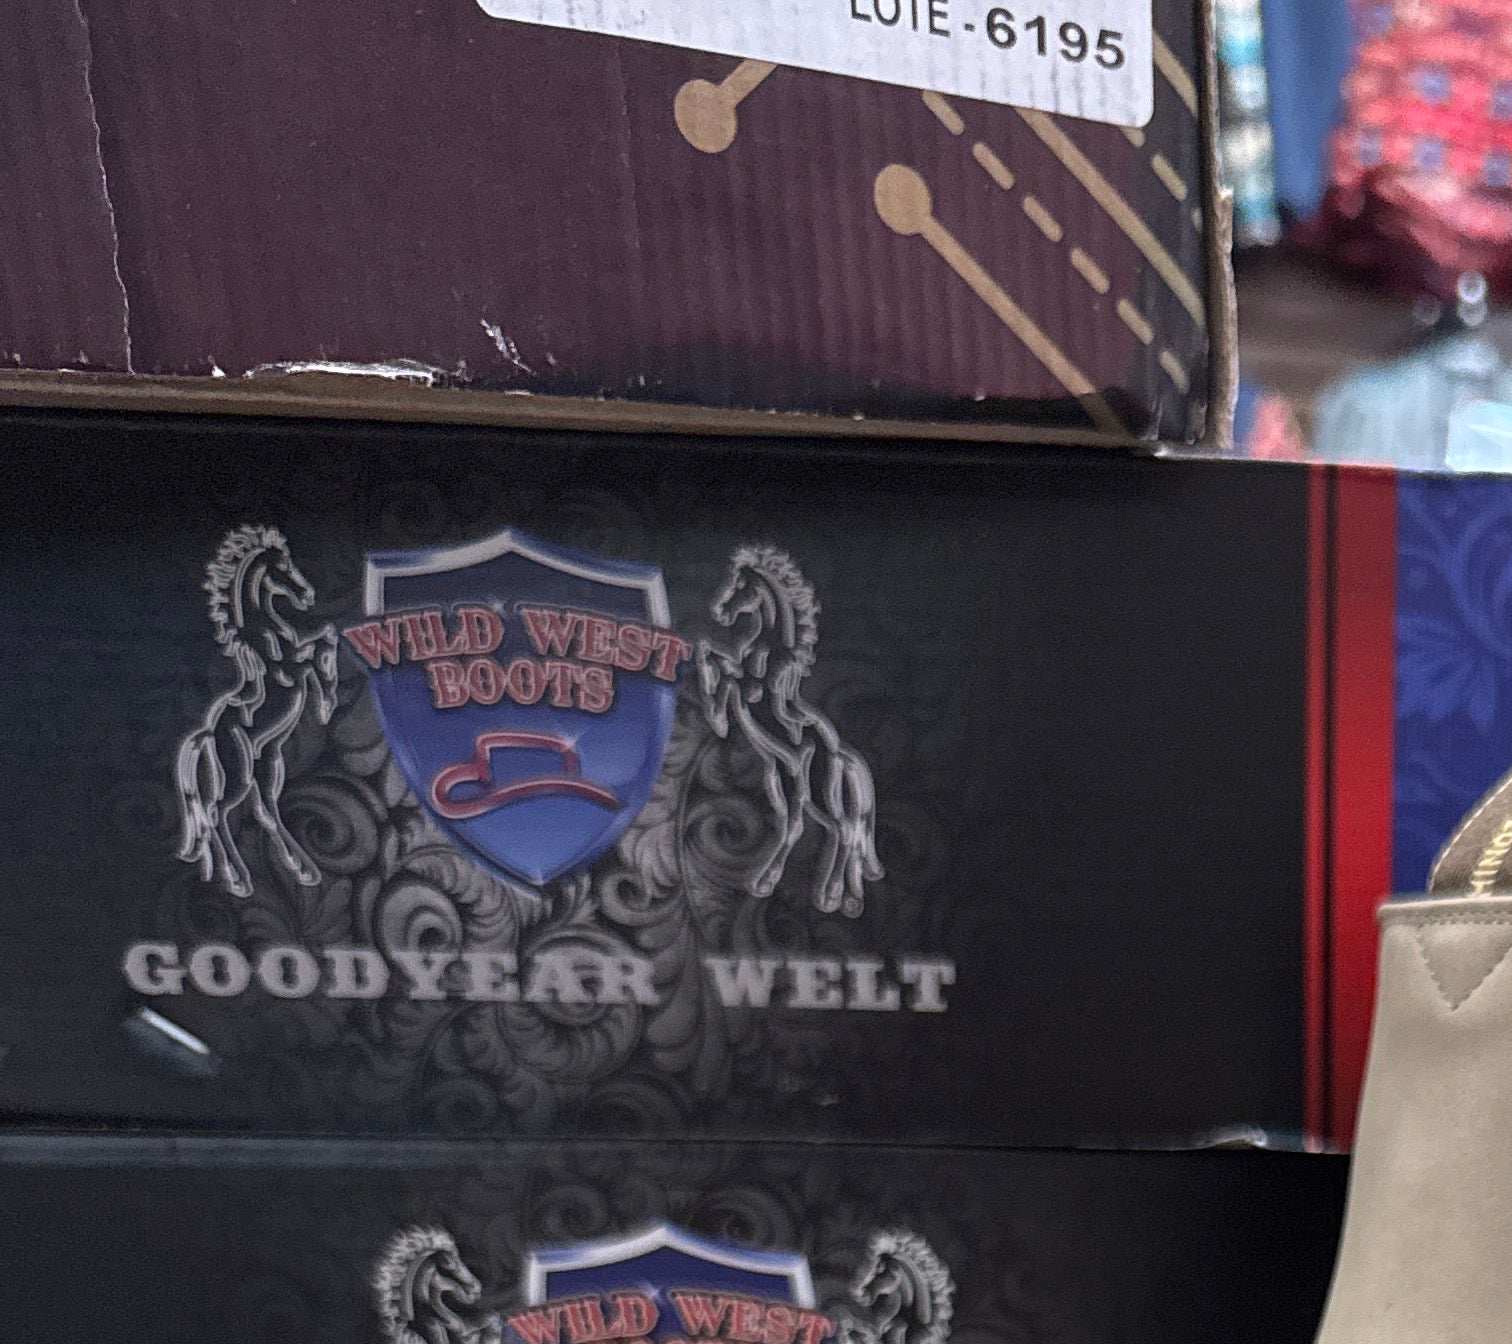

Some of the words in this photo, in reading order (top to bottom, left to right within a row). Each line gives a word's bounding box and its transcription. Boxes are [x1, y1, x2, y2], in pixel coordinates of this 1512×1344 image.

[985, 7, 1126, 70] 6195
[343, 608, 505, 670] WILD
[519, 606, 693, 682] WEST
[427, 657, 616, 714] BOOTS
[122, 943, 664, 1002] GOODYEAR
[703, 955, 957, 1014] WELT
